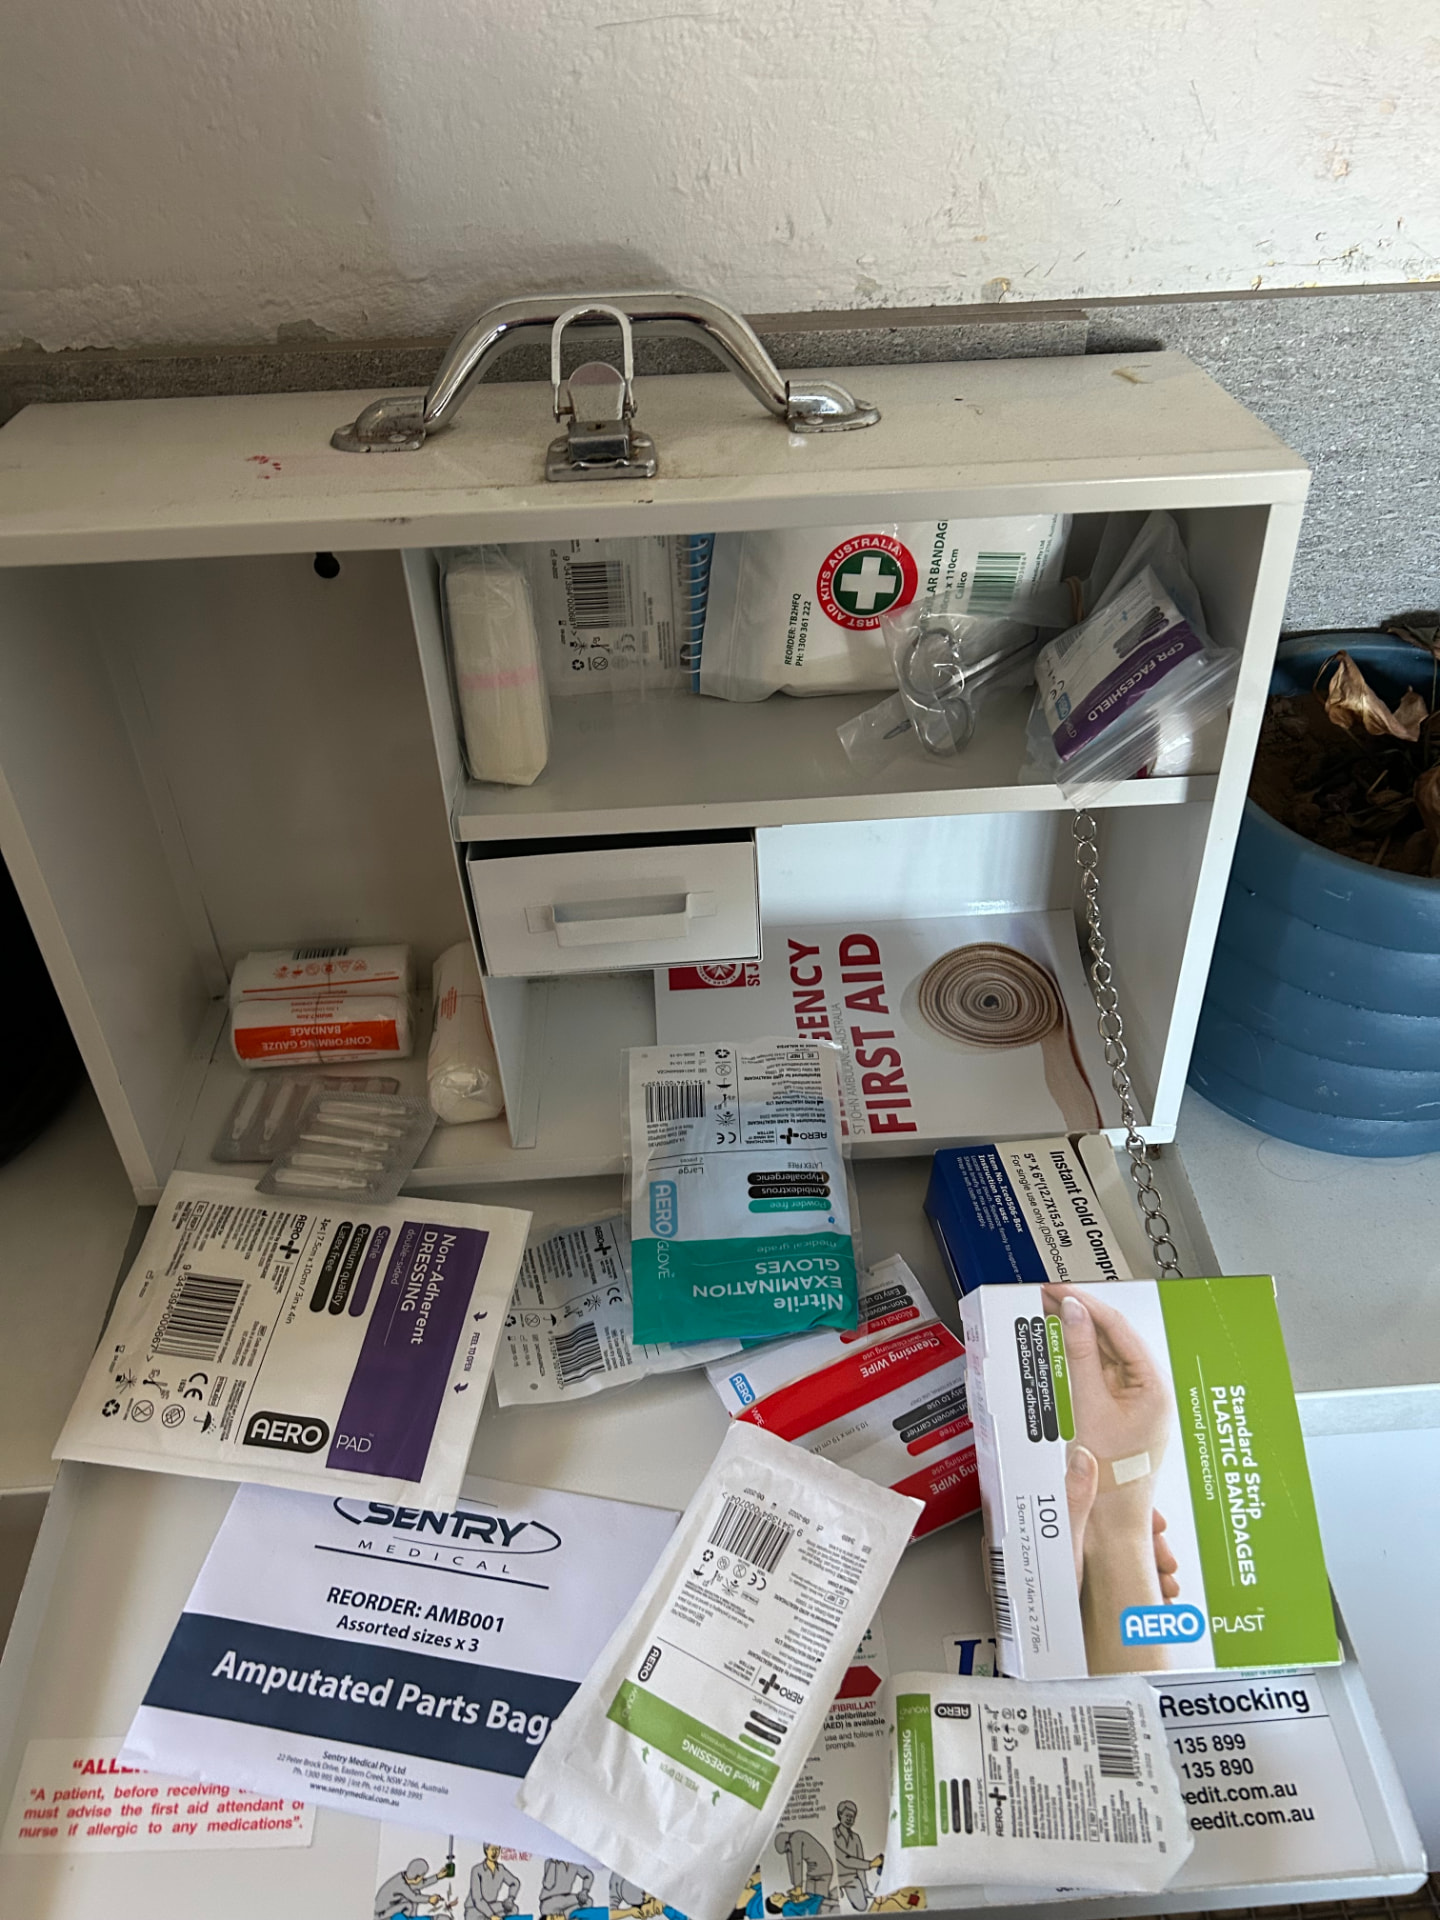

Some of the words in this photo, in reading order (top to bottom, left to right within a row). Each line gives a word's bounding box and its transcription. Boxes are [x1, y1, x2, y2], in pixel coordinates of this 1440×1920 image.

[828, 537, 900, 566] AUSTRALIA
[929, 519, 948, 574] BANDAG
[946, 548, 958, 580] 110cm
[821, 569, 831, 601] KITS
[955, 571, 967, 599] Calico
[789, 592, 801, 626] TB2HFQ
[802, 600, 811, 616] 222
[824, 605, 845, 624] AID
[799, 617, 809, 632] 361
[783, 626, 797, 665] REORDER:
[797, 633, 807, 651] 1300
[1155, 637, 1186, 665] CPR
[795, 653, 804, 666] PH:
[1084, 658, 1158, 723] FACESHIELD
[746, 973, 760, 986] St
[837, 930, 889, 1018] AID
[289, 1024, 341, 1036] BANDAGE
[298, 1035, 371, 1048] CONFORMING
[261, 1040, 297, 1050] GAUZE
[850, 1022, 917, 1135] FIRST
[849, 1097, 865, 1122] JOHN
[799, 1131, 827, 1139] AERO
[677, 1166, 704, 1175] Large
[1010, 1153, 1022, 1167] For
[755, 1172, 823, 1182] Hypoallergenic
[977, 1153, 998, 1193] Instruction
[993, 1193, 1003, 1206] for
[998, 1206, 1010, 1223] use:
[1015, 1166, 1033, 1192] single
[761, 1186, 825, 1195] Ambidextrous
[987, 1152, 999, 1171] Item
[994, 1170, 1004, 1184] No.
[999, 1184, 1024, 1233] Ice0506-Box
[1025, 1191, 1037, 1207] use
[653, 1184, 670, 1234] AERO
[769, 1202, 789, 1210] free
[792, 1200, 826, 1209] Powder
[988, 1203, 1002, 1227] Squeeze
[1048, 1147, 1082, 1196] Instant
[1071, 1194, 1098, 1228] Cold
[1085, 1226, 1120, 1284] Compre
[289, 1214, 307, 1241] AERO
[333, 1223, 350, 1251] Latex
[1056, 1227, 1072, 1249] CM)
[344, 1226, 368, 1270] Premium
[368, 1228, 388, 1260] Sterile
[756, 1243, 789, 1253] grade
[792, 1241, 836, 1249] medical
[324, 1250, 339, 1272] free
[389, 1228, 416, 1286] double-sided
[655, 1239, 670, 1279] GLOVE
[754, 1259, 839, 1273] GLOVES
[298, 1263, 312, 1285] 10cm
[400, 1229, 438, 1313] DRESSING
[166, 1275, 187, 1311] 341394
[330, 1270, 351, 1306] quality
[409, 1232, 456, 1346] Non-Adherent
[691, 1275, 843, 1296] EXAMINATION
[882, 1286, 900, 1298] Easy
[773, 1293, 843, 1311] Nitrile
[869, 1318, 886, 1329] free
[885, 1309, 914, 1324] Alcohol
[149, 1312, 171, 1350] 000667
[469, 1331, 480, 1347] PEEL
[1048, 1322, 1061, 1352] Latex
[887, 1335, 940, 1363] Cleansing
[463, 1354, 473, 1372] OPEN
[859, 1357, 889, 1378] WIPE
[1031, 1322, 1053, 1411] Hypo-allergenic
[1053, 1354, 1065, 1378] free
[732, 1375, 753, 1404] AERO
[750, 1406, 764, 1426] WIPE
[925, 1398, 940, 1411] use
[1025, 1387, 1040, 1435] adhesive
[1188, 1386, 1208, 1430] wound
[251, 1419, 323, 1447] AERO
[904, 1419, 932, 1438] carrier
[938, 1424, 955, 1438] free
[1209, 1385, 1238, 1467] PLASTIC
[1228, 1384, 1257, 1468] Standard
[336, 1434, 372, 1453] PAD
[930, 1464, 945, 1476] use
[1194, 1432, 1216, 1501] protection
[929, 1471, 960, 1494] WIPE
[1241, 1471, 1265, 1520] Strip
[364, 1501, 534, 1547] SENTRY
[1036, 1493, 1059, 1540] 100
[1223, 1470, 1256, 1586] BANDAGES
[358, 1538, 511, 1574] MEDICAL
[1018, 1535, 1032, 1566] 7.2cm
[1023, 1576, 1035, 1604] 3/4in
[327, 1586, 422, 1619] REORDER:
[424, 1603, 505, 1633] AMB001
[336, 1615, 410, 1641] Assorted
[412, 1628, 451, 1648] sizes
[1125, 1612, 1198, 1637] AERO
[1212, 1615, 1265, 1633] PLAST
[1028, 1623, 1041, 1654] 7/8in
[637, 1647, 660, 1681] AERO
[211, 1650, 388, 1708] Amputated
[397, 1688, 479, 1725] Parts
[777, 1684, 804, 1704] AERO
[834, 1709, 876, 1721] defibrillator
[937, 1705, 969, 1717] AERO
[1159, 1688, 1310, 1718] Restocking
[822, 1721, 843, 1731] (AED)
[853, 1716, 885, 1727] available
[852, 1730, 874, 1738] follow
[825, 1740, 855, 1750] prompts.
[1174, 1736, 1207, 1754] 135
[1212, 1733, 1246, 1752] 899
[322, 1750, 348, 1764] Sentry
[348, 1755, 378, 1769] Medical
[392, 1765, 406, 1774] Ltd
[679, 1737, 733, 1776] DRESSING
[902, 1729, 913, 1791] DRESSING
[1181, 1760, 1215, 1779] 135
[1221, 1758, 1254, 1777] 890
[340, 1766, 365, 1777] Eastern
[420, 1782, 449, 1795] Australia
[731, 1768, 762, 1792] Wound
[53, 1785, 105, 1803] patient,
[114, 1783, 158, 1800] before
[166, 1783, 230, 1798] receiving
[23, 1806, 59, 1820] must
[67, 1805, 112, 1819] advise
[120, 1803, 142, 1817] the
[151, 1800, 178, 1815] first
[187, 1800, 209, 1814] aid
[216, 1798, 284, 1813] attendant
[905, 1793, 914, 1836] Wound
[19, 1825, 58, 1838] nurse
[86, 1821, 138, 1838] allergic
[172, 1821, 198, 1836] any
